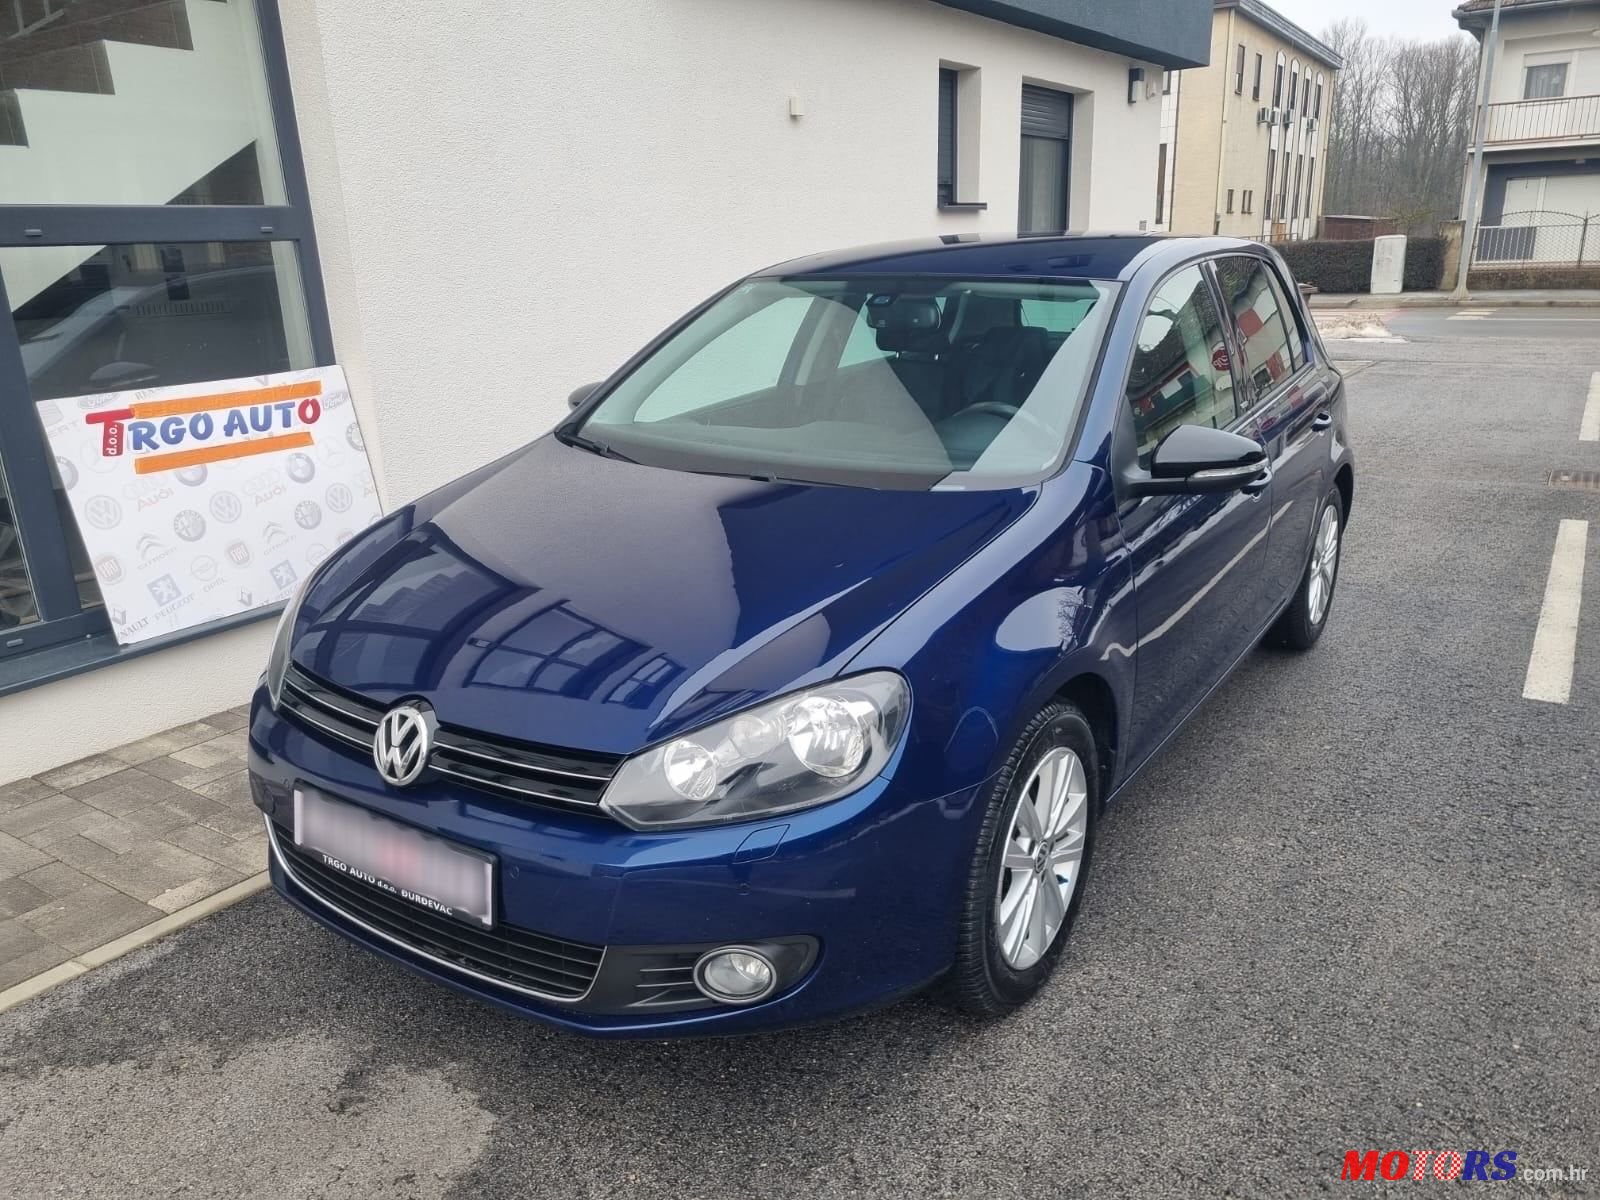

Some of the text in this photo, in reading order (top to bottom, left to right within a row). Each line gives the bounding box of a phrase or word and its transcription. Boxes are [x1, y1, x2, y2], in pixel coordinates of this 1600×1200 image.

[85, 398, 321, 456] TRGO AUTO
[106, 424, 118, 455] d.o.o.
[322, 854, 347, 873] TRGO
[349, 867, 376, 885] AUTO
